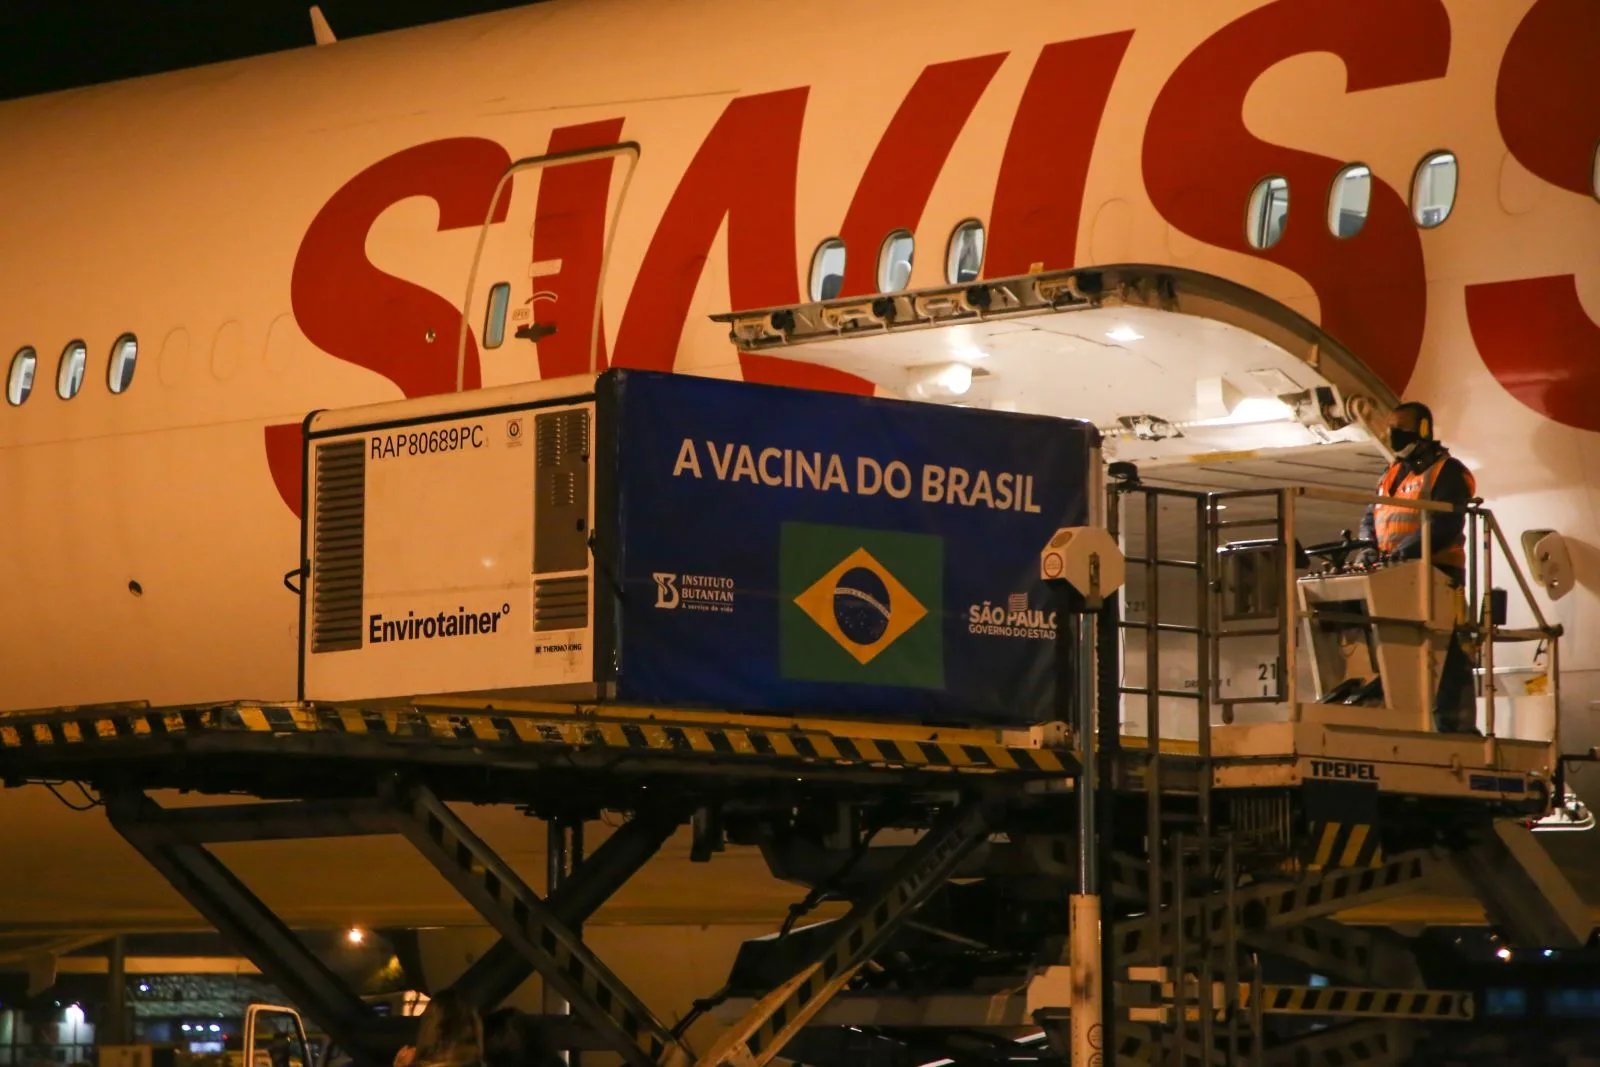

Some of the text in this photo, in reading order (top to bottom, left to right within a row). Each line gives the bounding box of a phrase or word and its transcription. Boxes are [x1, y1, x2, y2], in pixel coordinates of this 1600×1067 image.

[371, 425, 484, 459] RAP80689PC
[672, 438, 1041, 513] A VACINA DO BRASIL
[682, 575, 734, 589] INSTITUTO
[682, 588, 734, 602] BUTANTAN
[969, 600, 1005, 625] SÃO
[968, 624, 1056, 640] GOVERNO DO ESTAD
[1310, 760, 1380, 780] TREPEL
